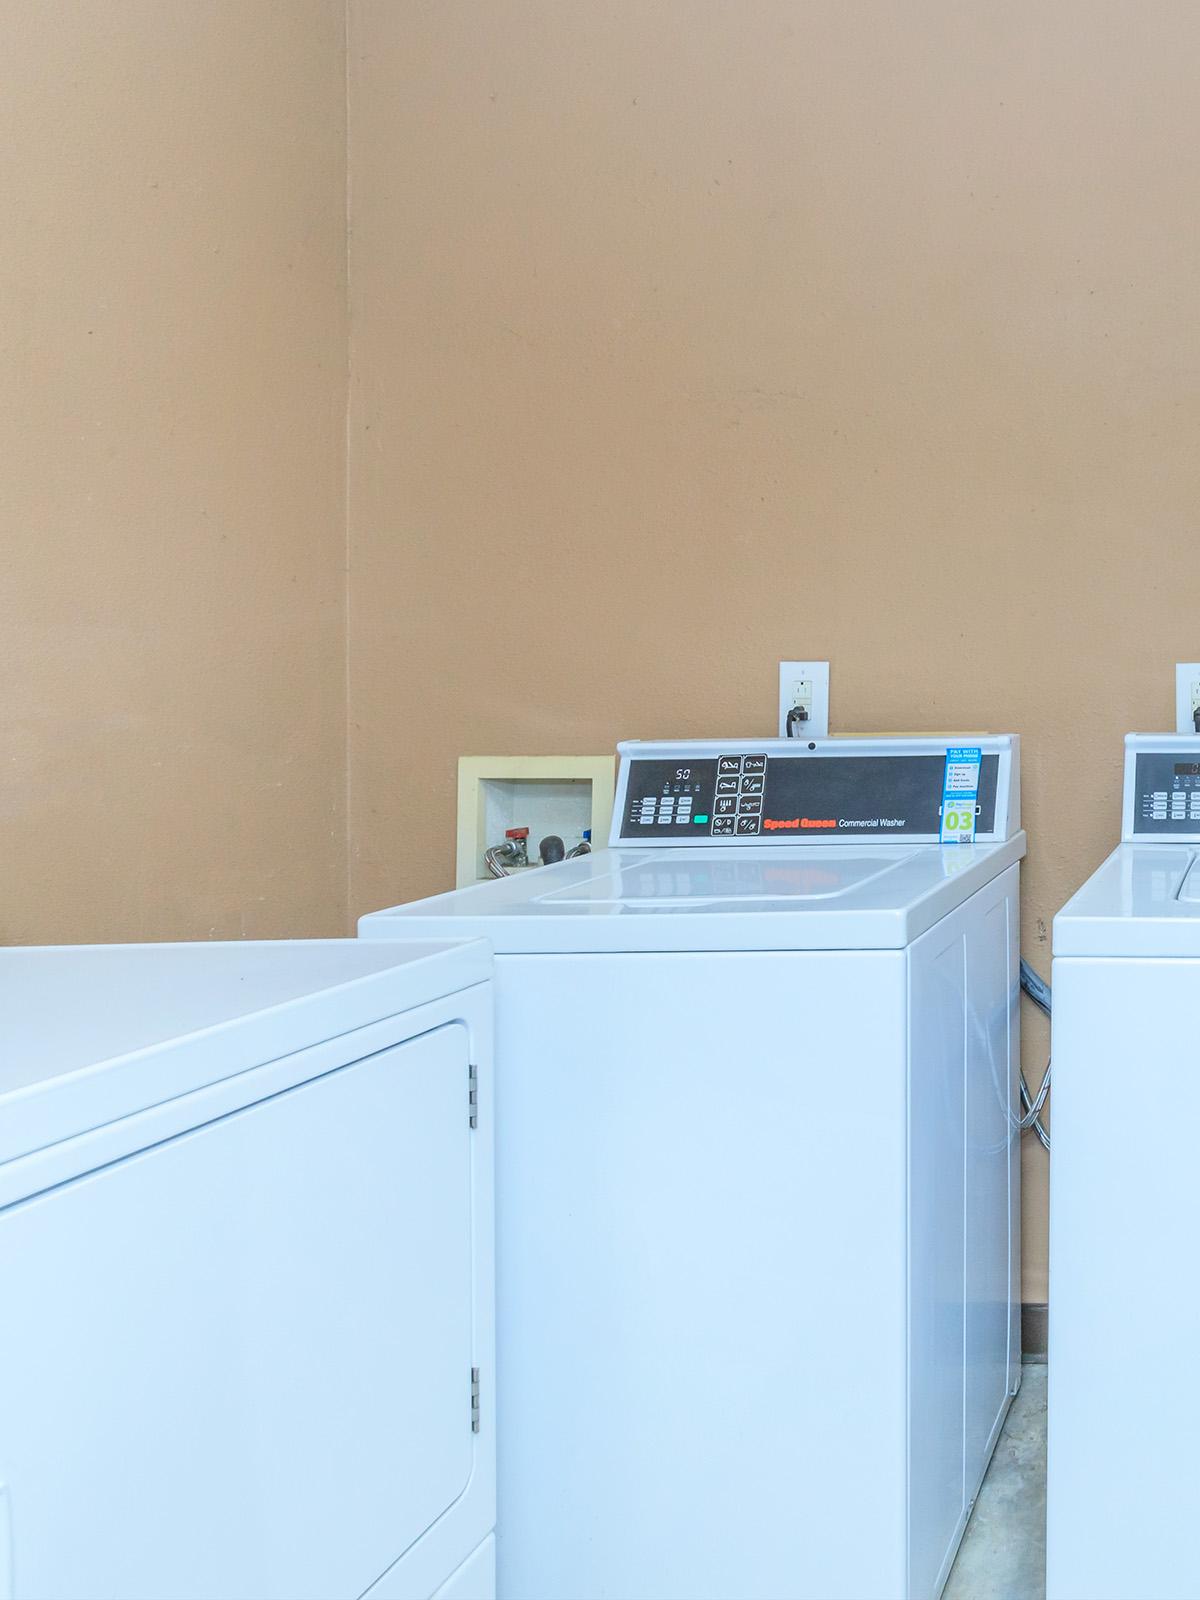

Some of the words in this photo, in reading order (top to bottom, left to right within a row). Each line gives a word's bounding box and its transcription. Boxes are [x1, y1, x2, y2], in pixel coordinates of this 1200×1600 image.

[763, 818, 799, 830] Speed
[800, 817, 837, 828] Queen
[838, 818, 879, 828] Commercial
[879, 818, 906, 827] Washer
[945, 811, 973, 831] 03
